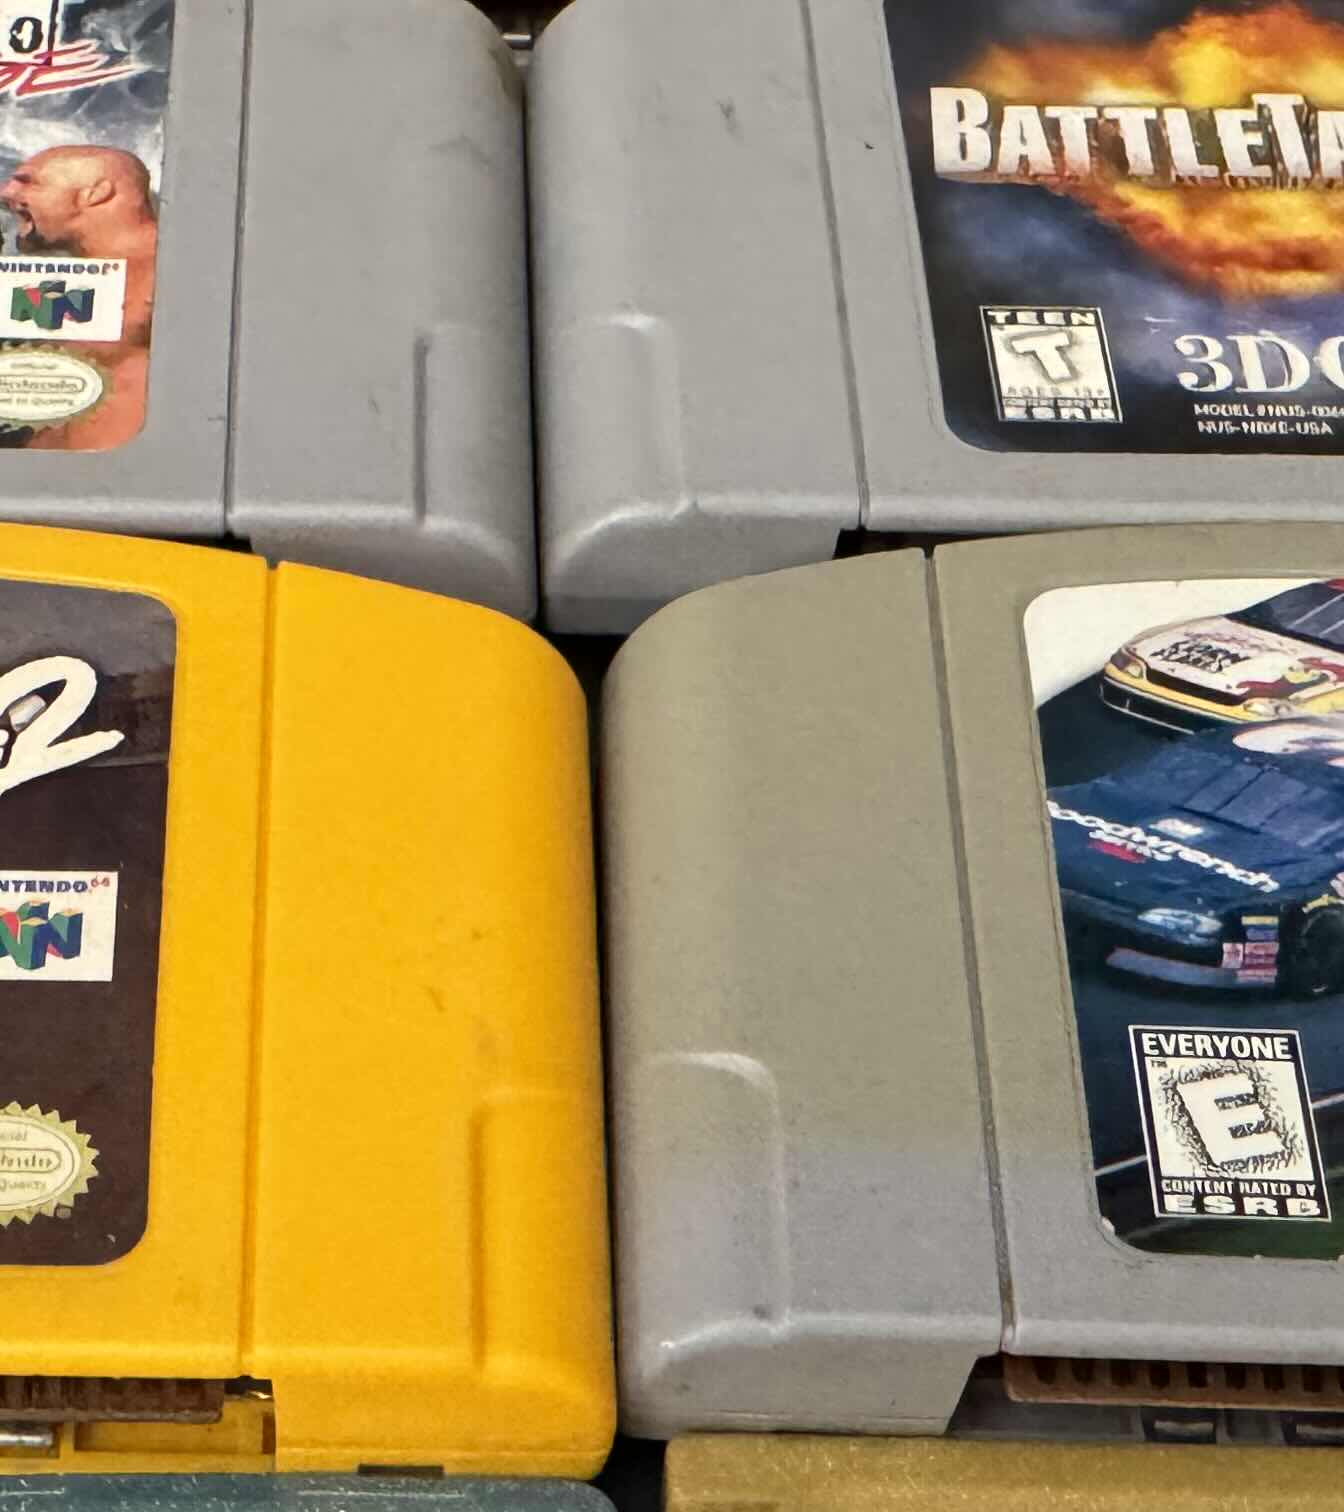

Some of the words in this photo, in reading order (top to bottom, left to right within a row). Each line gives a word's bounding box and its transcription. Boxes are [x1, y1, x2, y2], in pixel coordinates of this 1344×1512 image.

[987, 311, 1096, 326] TEEN
[1140, 1031, 1293, 1060] EVERYONE
[1176, 1070, 1293, 1166] E
[1160, 1178, 1234, 1195] CONTENT
[1238, 1180, 1291, 1196] RATED
[1295, 1182, 1317, 1197] BY
[1163, 1194, 1321, 1216] ESRB
